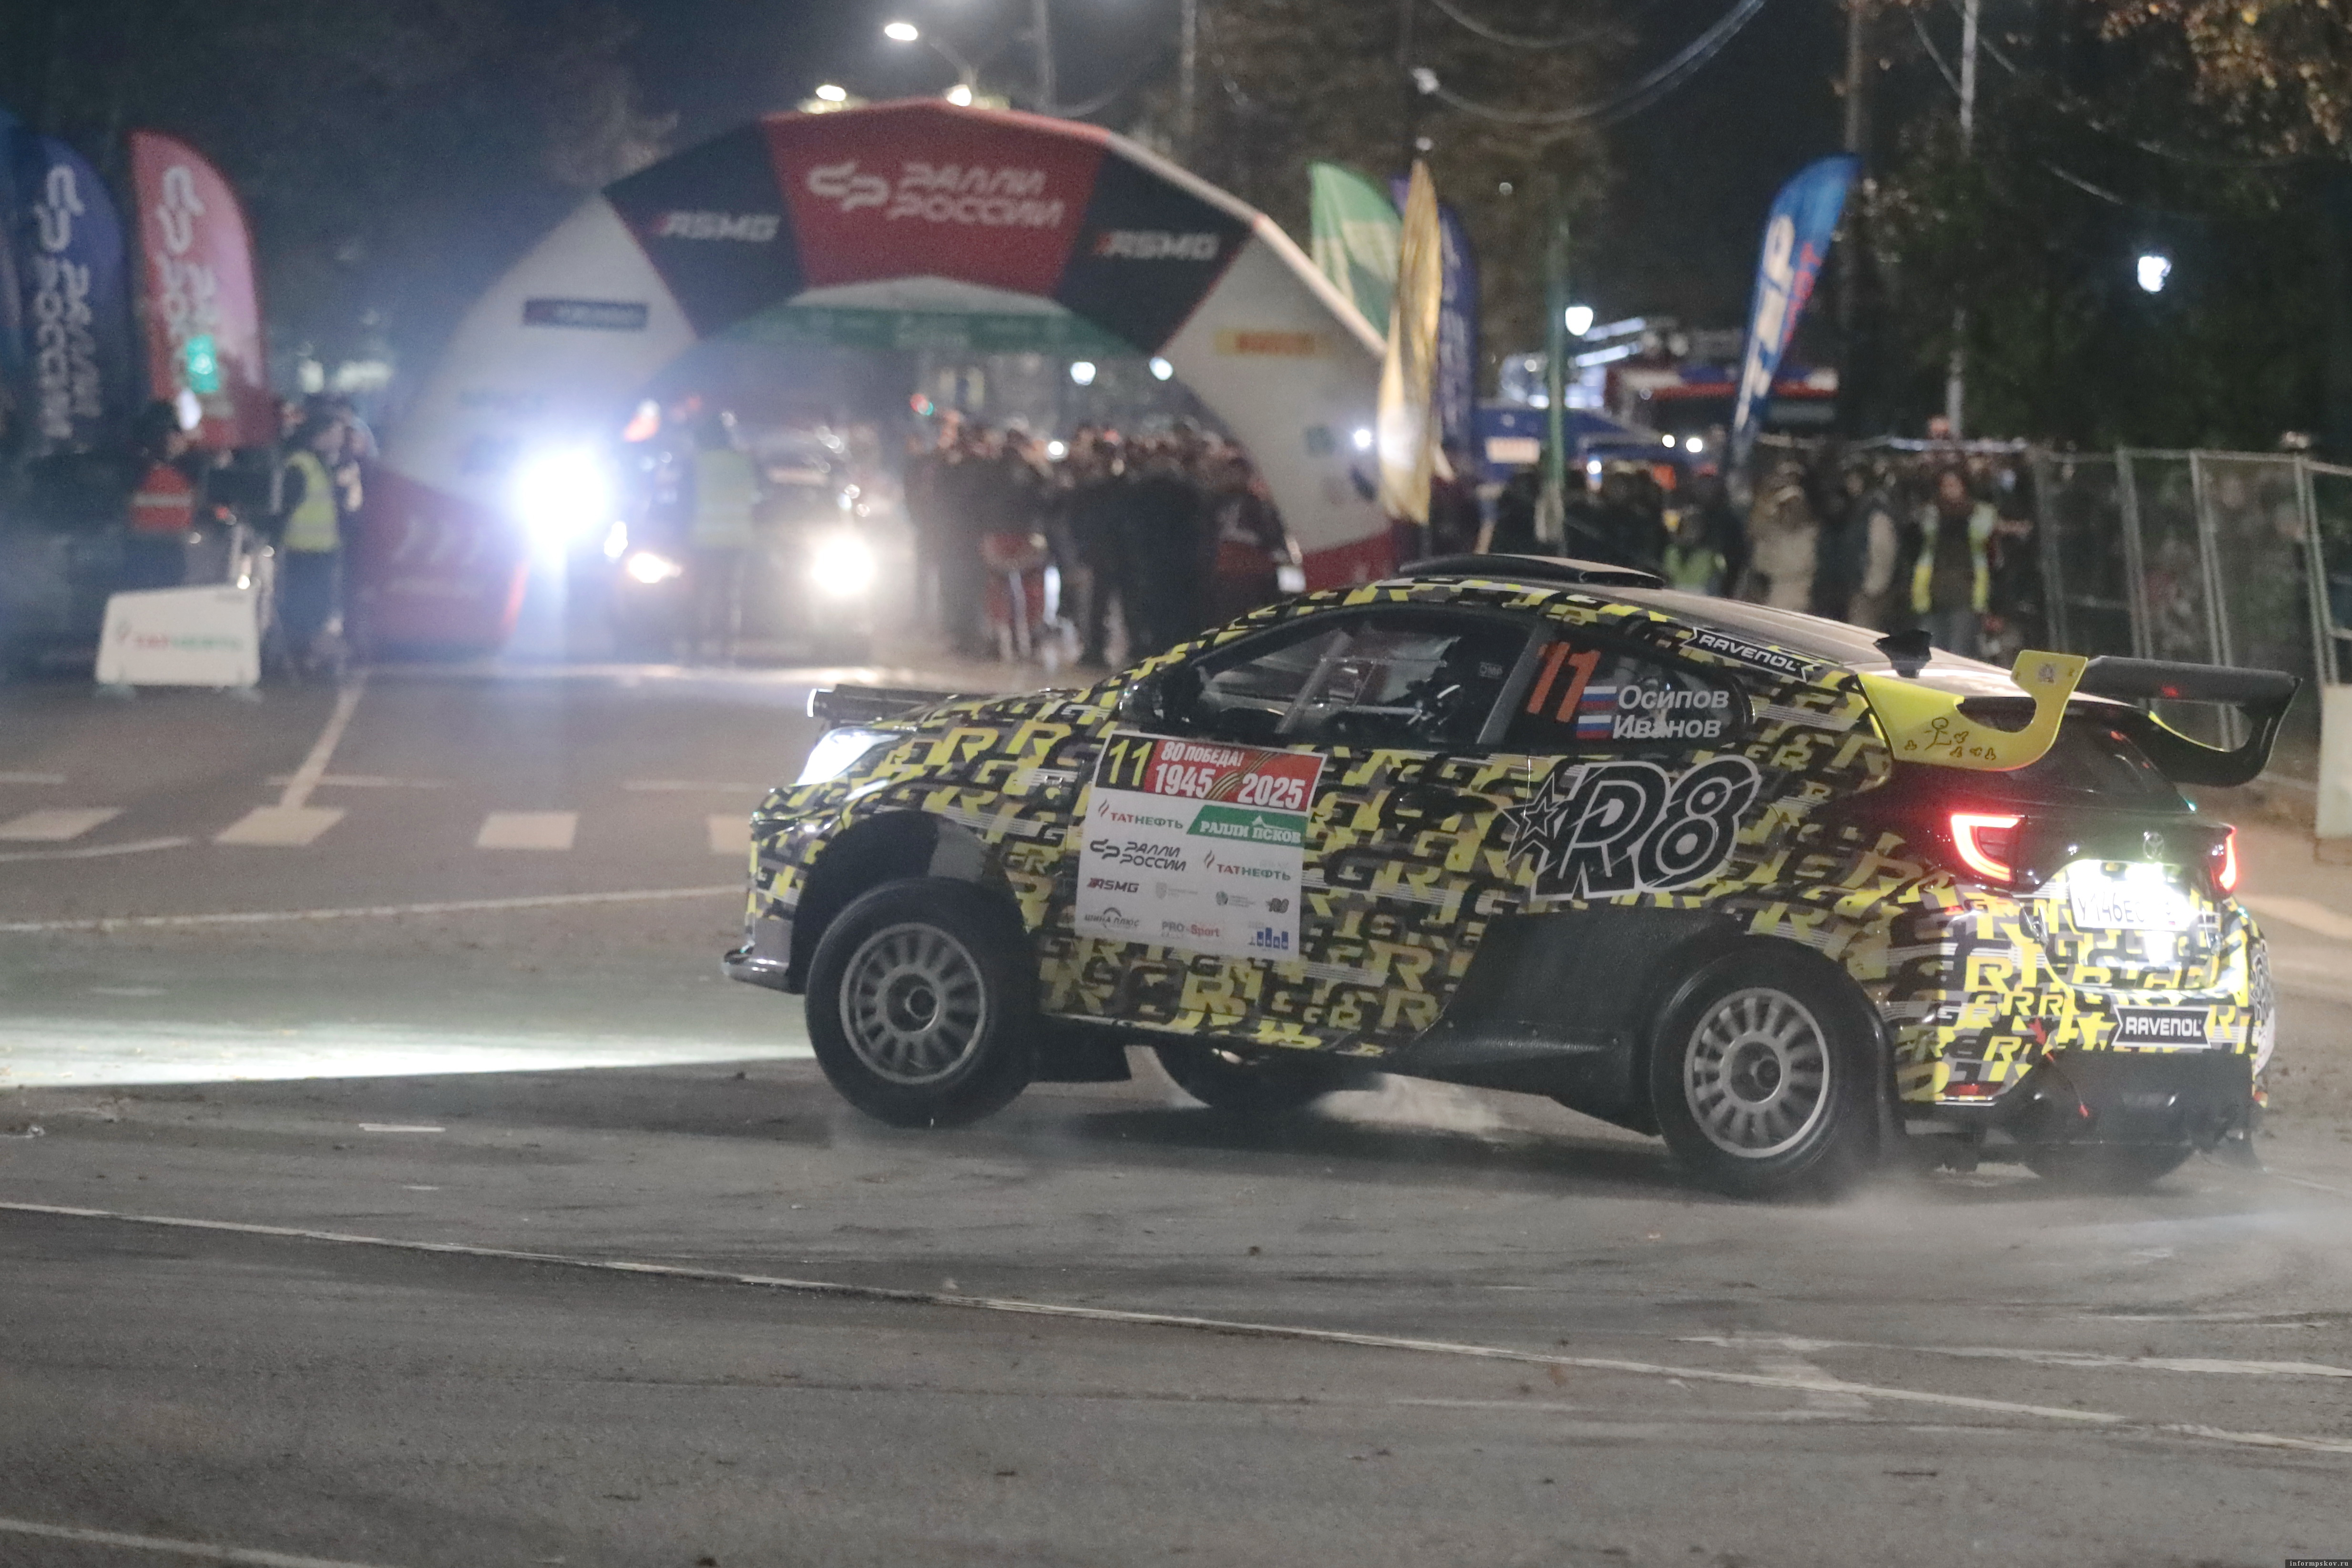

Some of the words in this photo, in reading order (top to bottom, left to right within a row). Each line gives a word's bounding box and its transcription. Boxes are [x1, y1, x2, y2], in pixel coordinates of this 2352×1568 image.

[1698, 634, 1796, 672] RAVENOL
[1527, 642, 1601, 723] 11
[1618, 685, 1729, 710] Осипов
[1612, 714, 1722, 739] Иванов
[1108, 739, 1152, 787] 11
[1161, 741, 1183, 762] 80
[1183, 746, 1245, 767] ПОБЕДА!
[1155, 763, 1217, 799] 1945
[1237, 772, 1306, 810] 2025
[1110, 812, 1184, 829] ТАТНЕФТЬ
[1199, 820, 1249, 838] РАЛЛИ
[1251, 826, 1302, 844] ПСКОВ
[1119, 856, 1186, 871] РОССИИ
[1217, 863, 1291, 881] ТАТНЕФТЬ
[2125, 1016, 2201, 1037] RAVENOL
